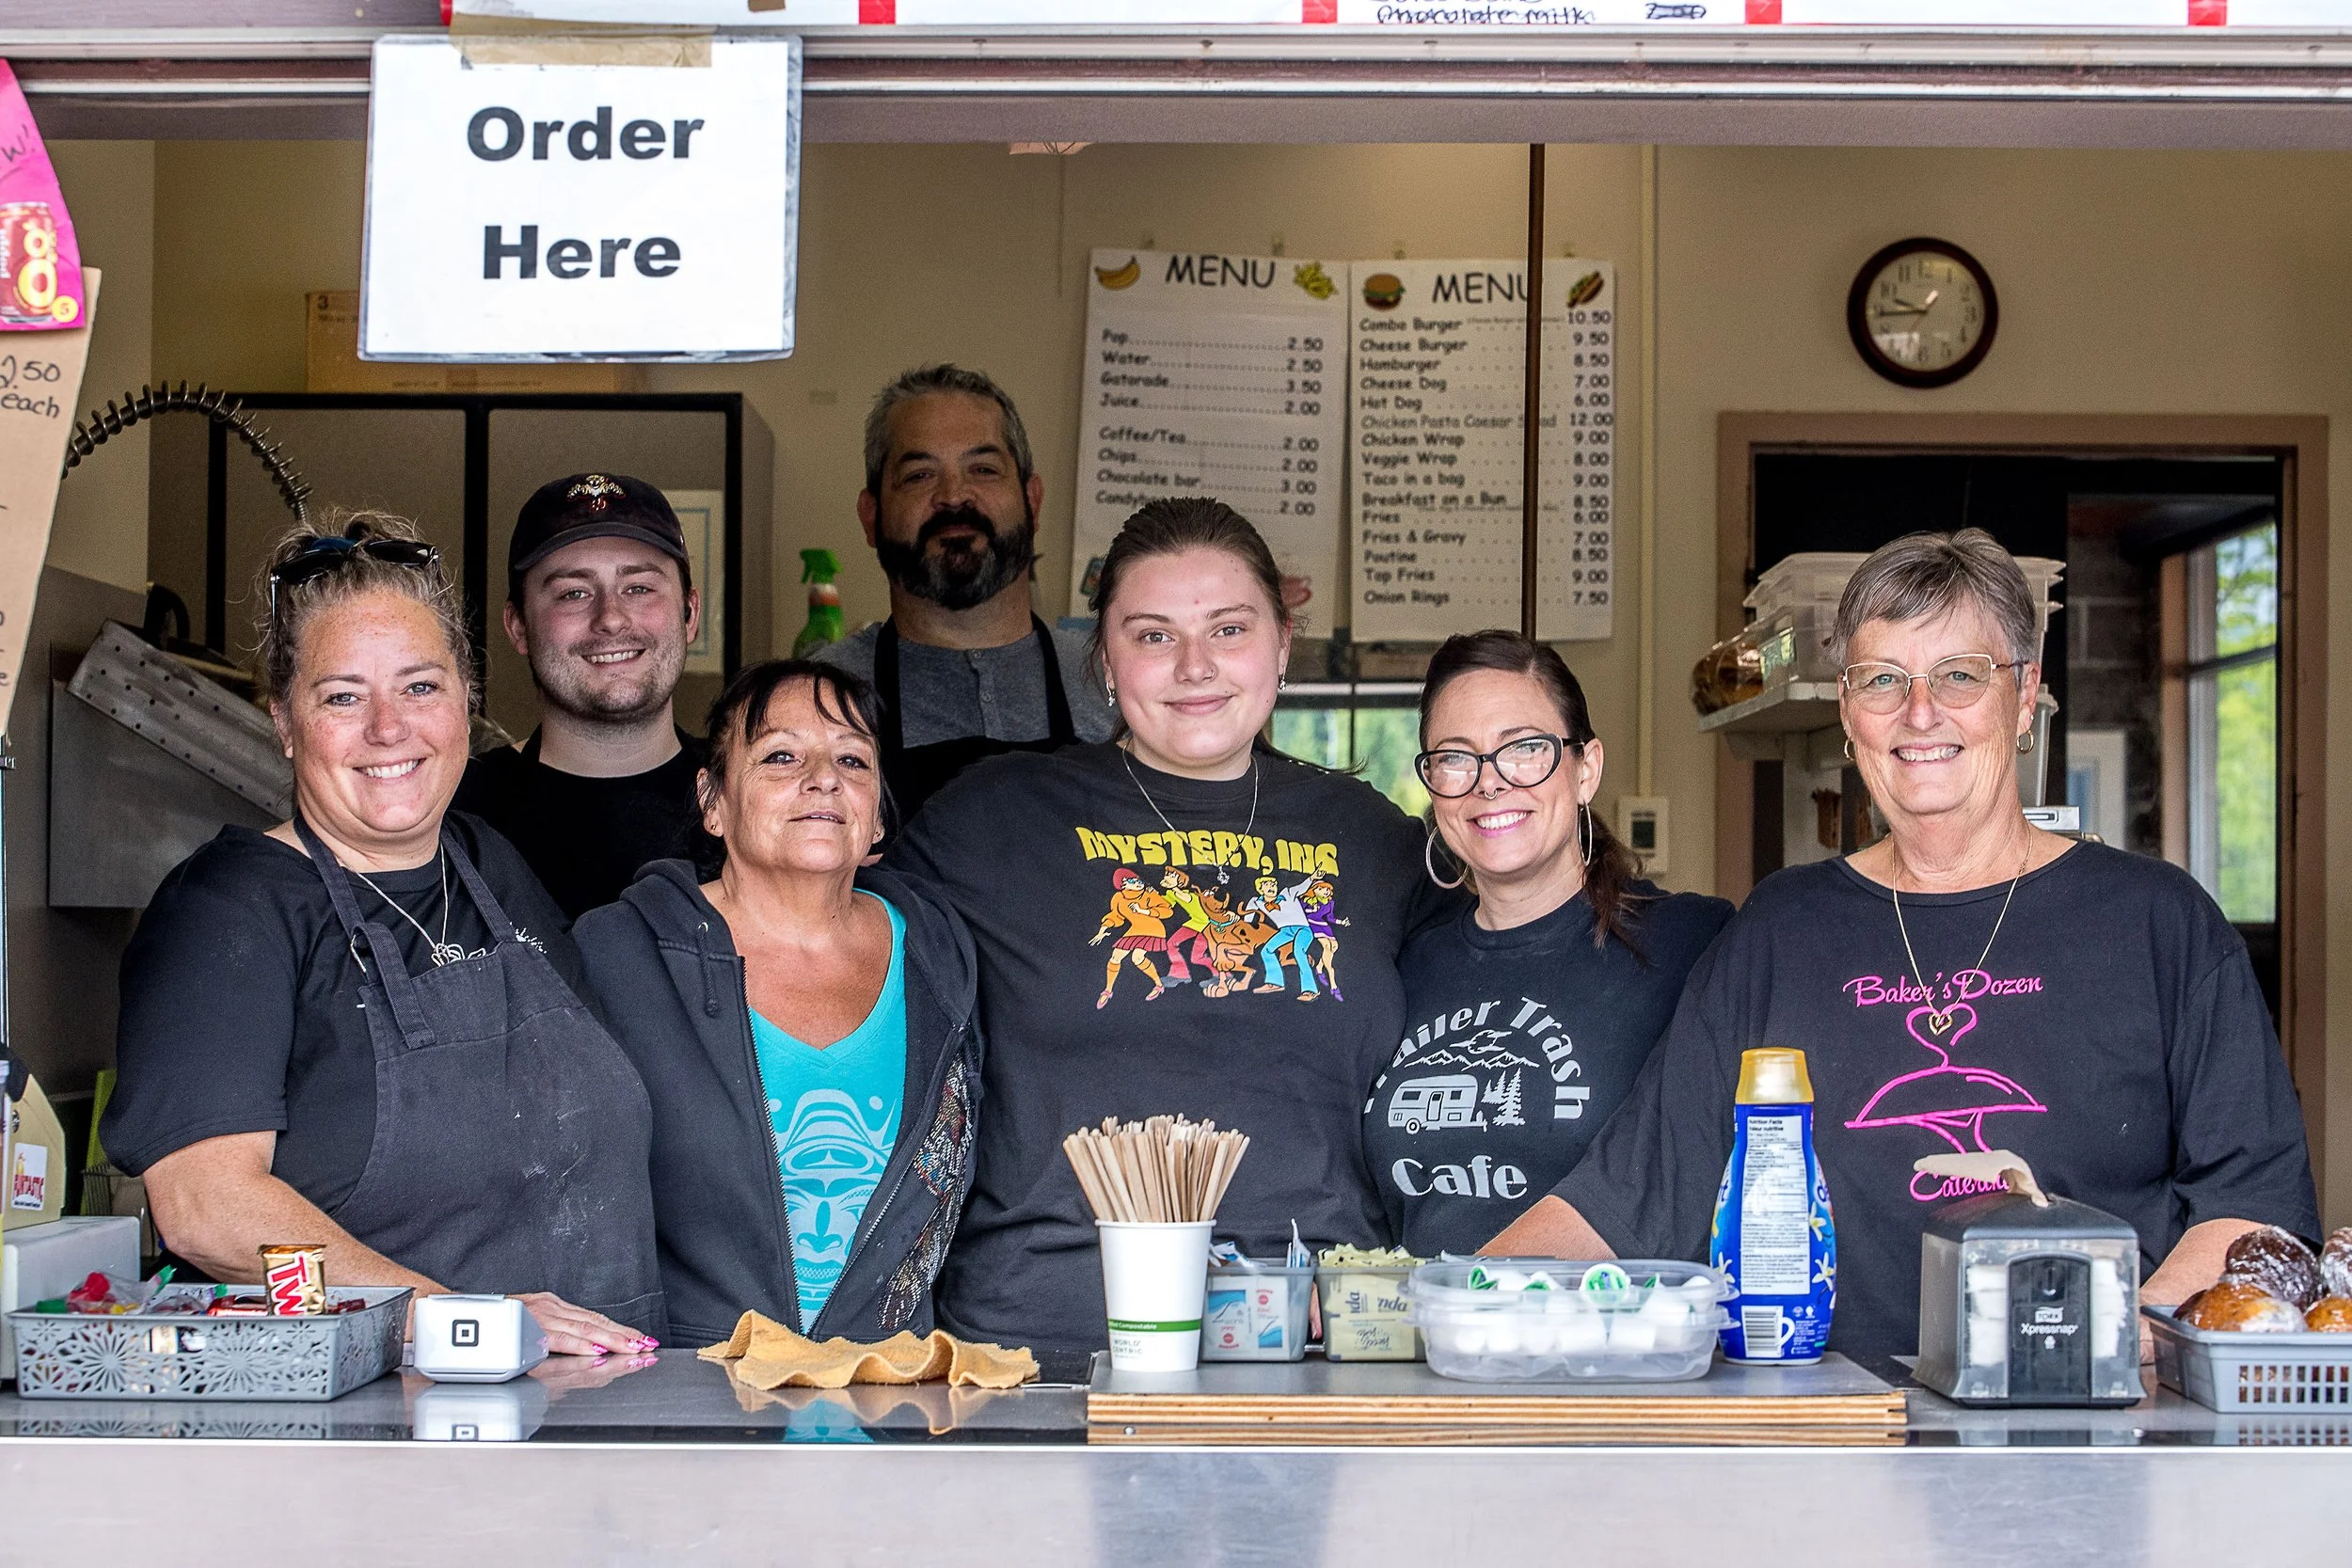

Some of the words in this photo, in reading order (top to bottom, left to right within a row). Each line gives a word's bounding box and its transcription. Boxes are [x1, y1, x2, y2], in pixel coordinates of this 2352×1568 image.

[468, 105, 706, 162] Order
[484, 224, 681, 279] Here
[1166, 255, 1276, 288] MENU
[1359, 318, 1406, 332] Combo
[1412, 318, 1462, 336] Burger
[1359, 339, 1411, 353] Cheese
[1418, 338, 1468, 356] Burger
[1102, 352, 1151, 366] Water
[1359, 357, 1441, 374] Hamburger
[1100, 372, 1169, 388] Gatorade
[1360, 377, 1412, 390] Cheese
[1419, 377, 1448, 393] Dog
[1574, 374, 1611, 388] 7.00
[0, 390, 60, 420] each
[1099, 392, 1139, 407] Juice
[1360, 396, 1388, 409] Hot
[1394, 396, 1422, 412] Dog
[1361, 415, 1418, 429] Chicken
[1421, 414, 1460, 428] Pasta
[1098, 425, 1186, 445] Coffee/Tea
[1362, 433, 1418, 447] Chicken
[1423, 433, 1465, 449] Wrap
[1098, 448, 1136, 466] Chips
[1362, 452, 1410, 468] Veggie
[1417, 451, 1458, 467] Wrap
[1096, 469, 1168, 486] Chocolate
[1174, 471, 1200, 488] bar
[1362, 472, 1398, 485] Taco
[1404, 472, 1417, 485] in
[1422, 475, 1432, 485] a
[1438, 472, 1465, 489] bag
[1362, 492, 1436, 506] Breakfast
[1441, 495, 1458, 506] on
[1465, 495, 1474, 505] a
[1480, 492, 1507, 506] Bun
[1362, 511, 1401, 524] Fries
[1362, 531, 1401, 544] Fries
[1407, 530, 1418, 544] &
[1422, 530, 1466, 546] Gravy
[1364, 550, 1417, 563] Poutine
[1397, 568, 1435, 580] Fries
[1364, 592, 1406, 604] Onion
[1411, 591, 1450, 608] Rings
[1074, 826, 1274, 876] MYSTERY,
[1842, 972, 1951, 1007] Baker's
[1951, 969, 2043, 1000] Dozen
[1509, 996, 1590, 1119] Trash
[1391, 1155, 1528, 1199] Cafe
